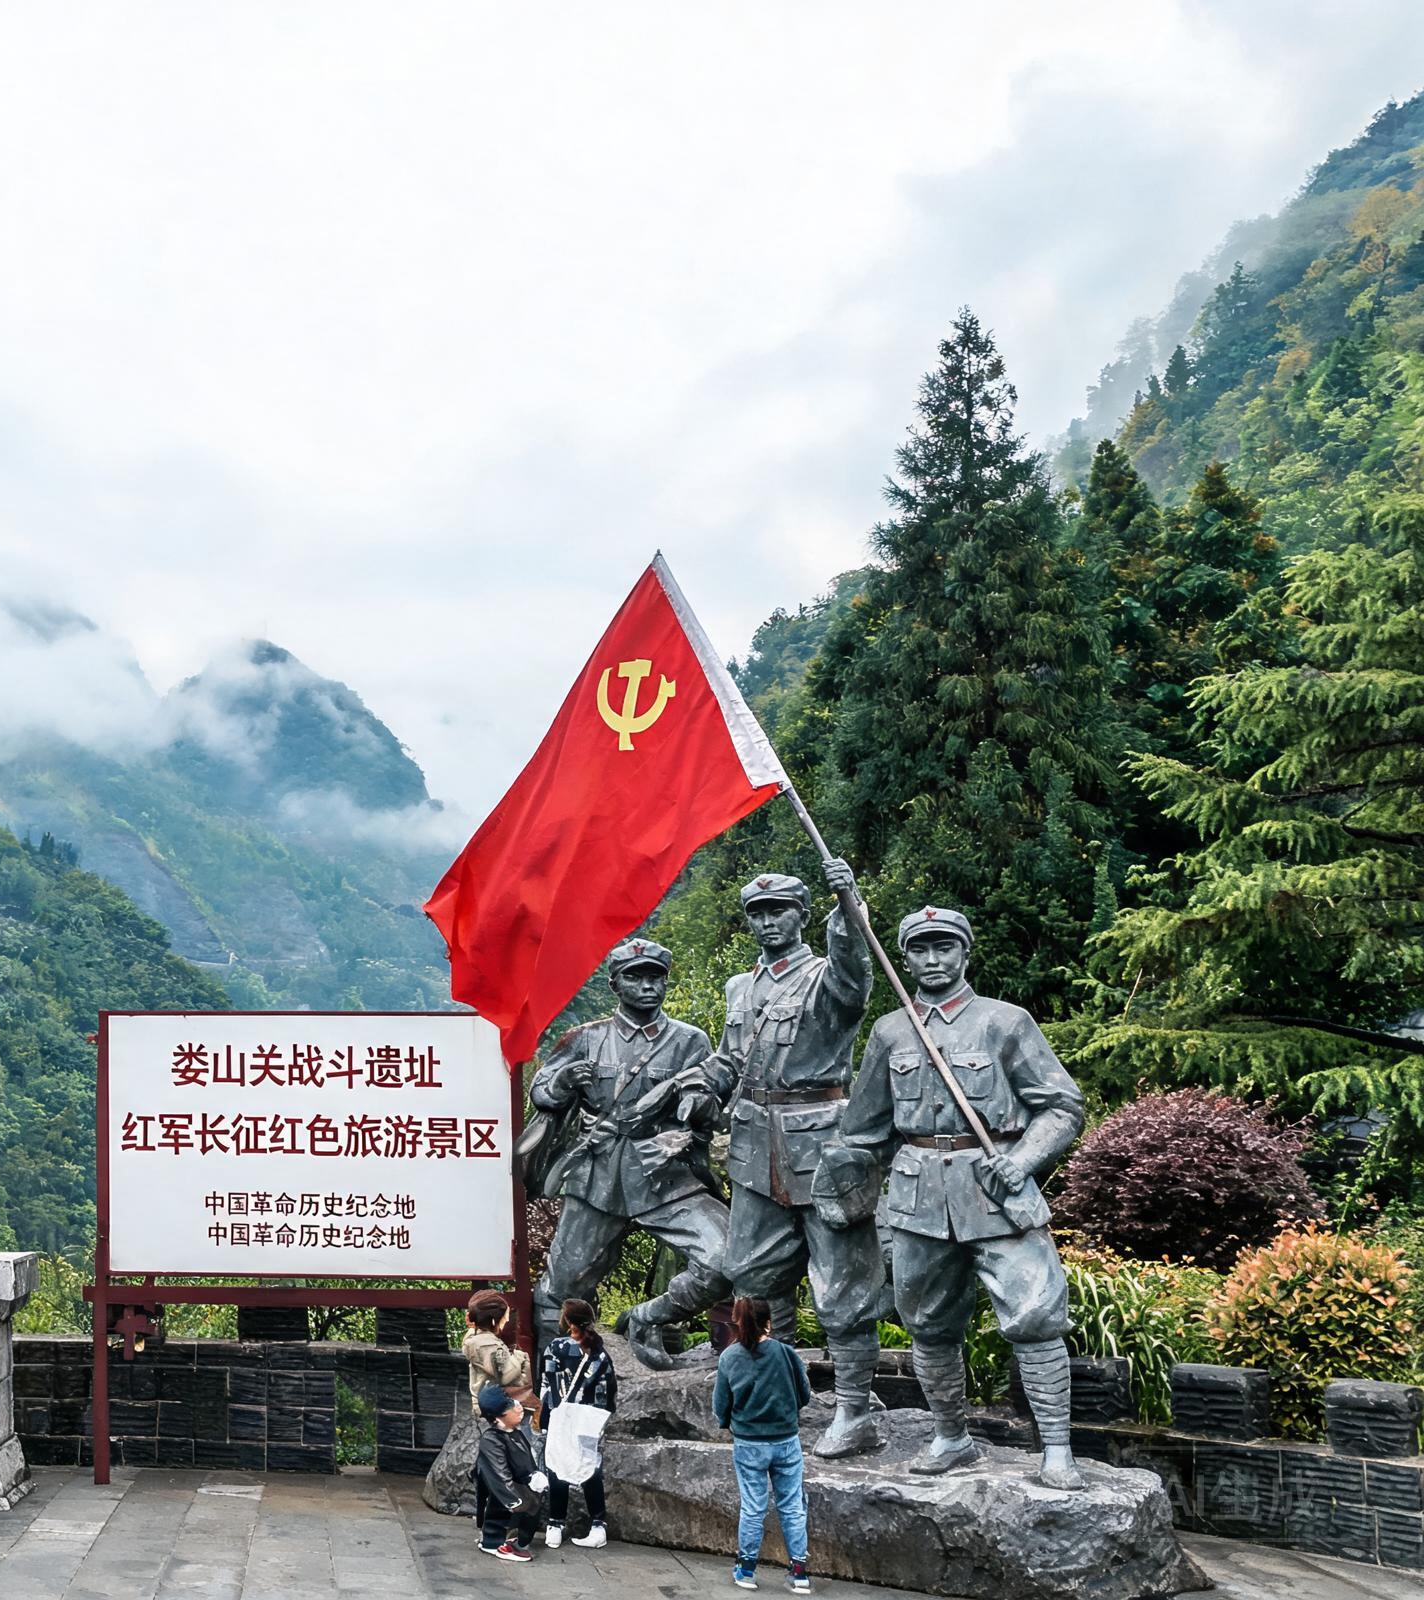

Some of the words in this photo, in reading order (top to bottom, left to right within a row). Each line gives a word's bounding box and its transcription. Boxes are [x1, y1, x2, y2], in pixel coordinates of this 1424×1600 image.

[171, 1043, 443, 1089] 娄山关战斗遗址
[121, 1111, 501, 1158] 红军长征红色旅游景区
[205, 1190, 417, 1219] 中国革命历史纪念地
[208, 1221, 411, 1250] 中国革命历史纪念地
